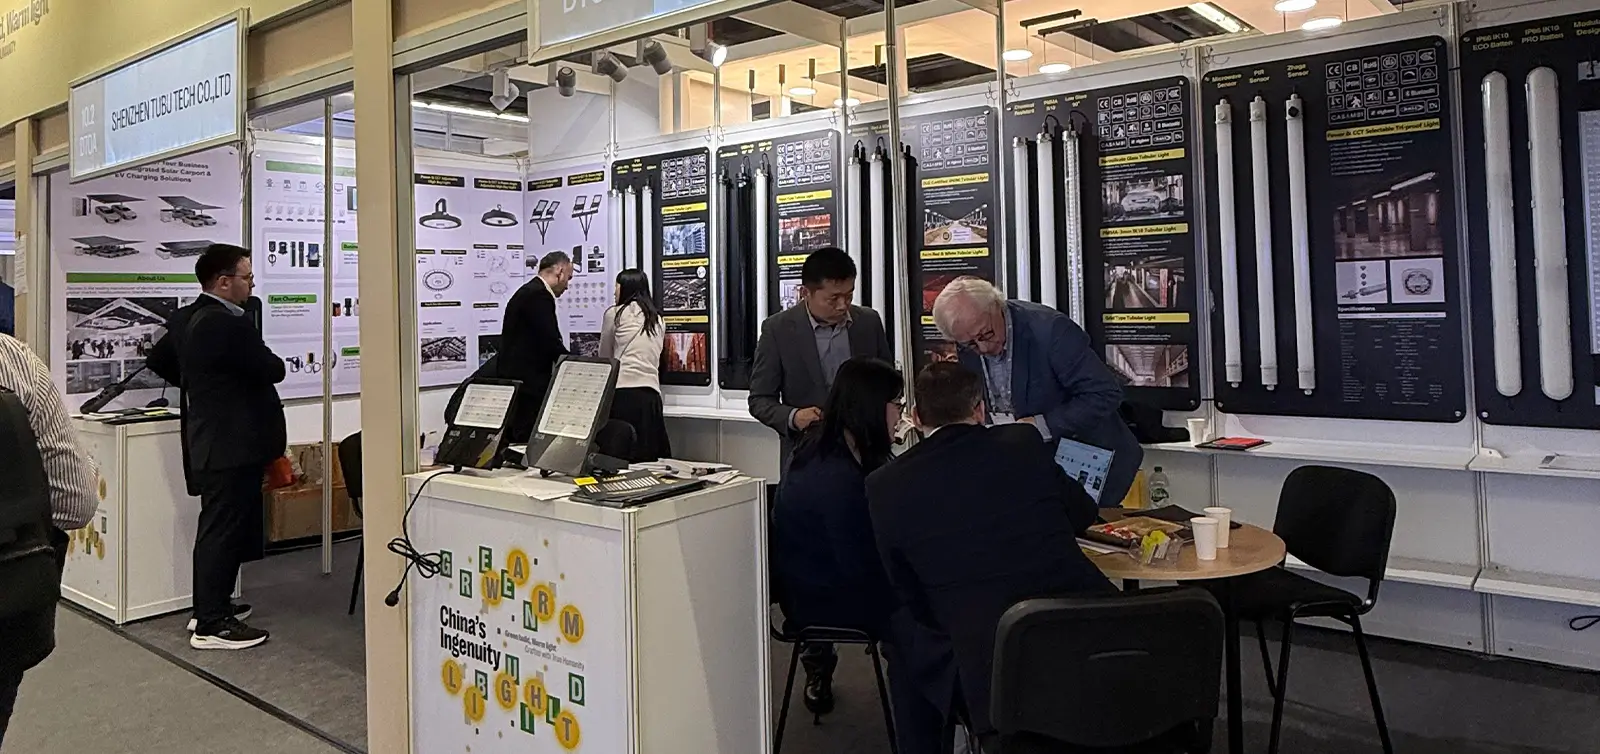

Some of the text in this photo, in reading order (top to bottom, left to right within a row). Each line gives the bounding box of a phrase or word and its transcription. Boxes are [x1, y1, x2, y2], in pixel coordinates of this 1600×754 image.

[1576, 28, 1600, 36] Desig
[1540, 33, 1564, 41] Batten
[1490, 40, 1513, 48] Batten
[1211, 73, 1242, 82] Microwave
[1287, 70, 1309, 78] Sensor
[1249, 76, 1270, 84] Sensor
[112, 102, 150, 132] SHENZHEN
[151, 92, 172, 119] TUBU
[173, 84, 196, 112] TECH
[81, 103, 95, 128] 10.2
[1366, 126, 1394, 134] Selectable
[1423, 121, 1439, 129] Light
[178, 161, 209, 169] Business
[180, 168, 206, 177] Carport
[126, 172, 159, 182] Charging
[160, 175, 192, 183] Solutions
[282, 295, 307, 303] Charging
[440, 605, 486, 639] China's
[505, 629, 519, 640] Green
[440, 627, 501, 671] Ingenuity
